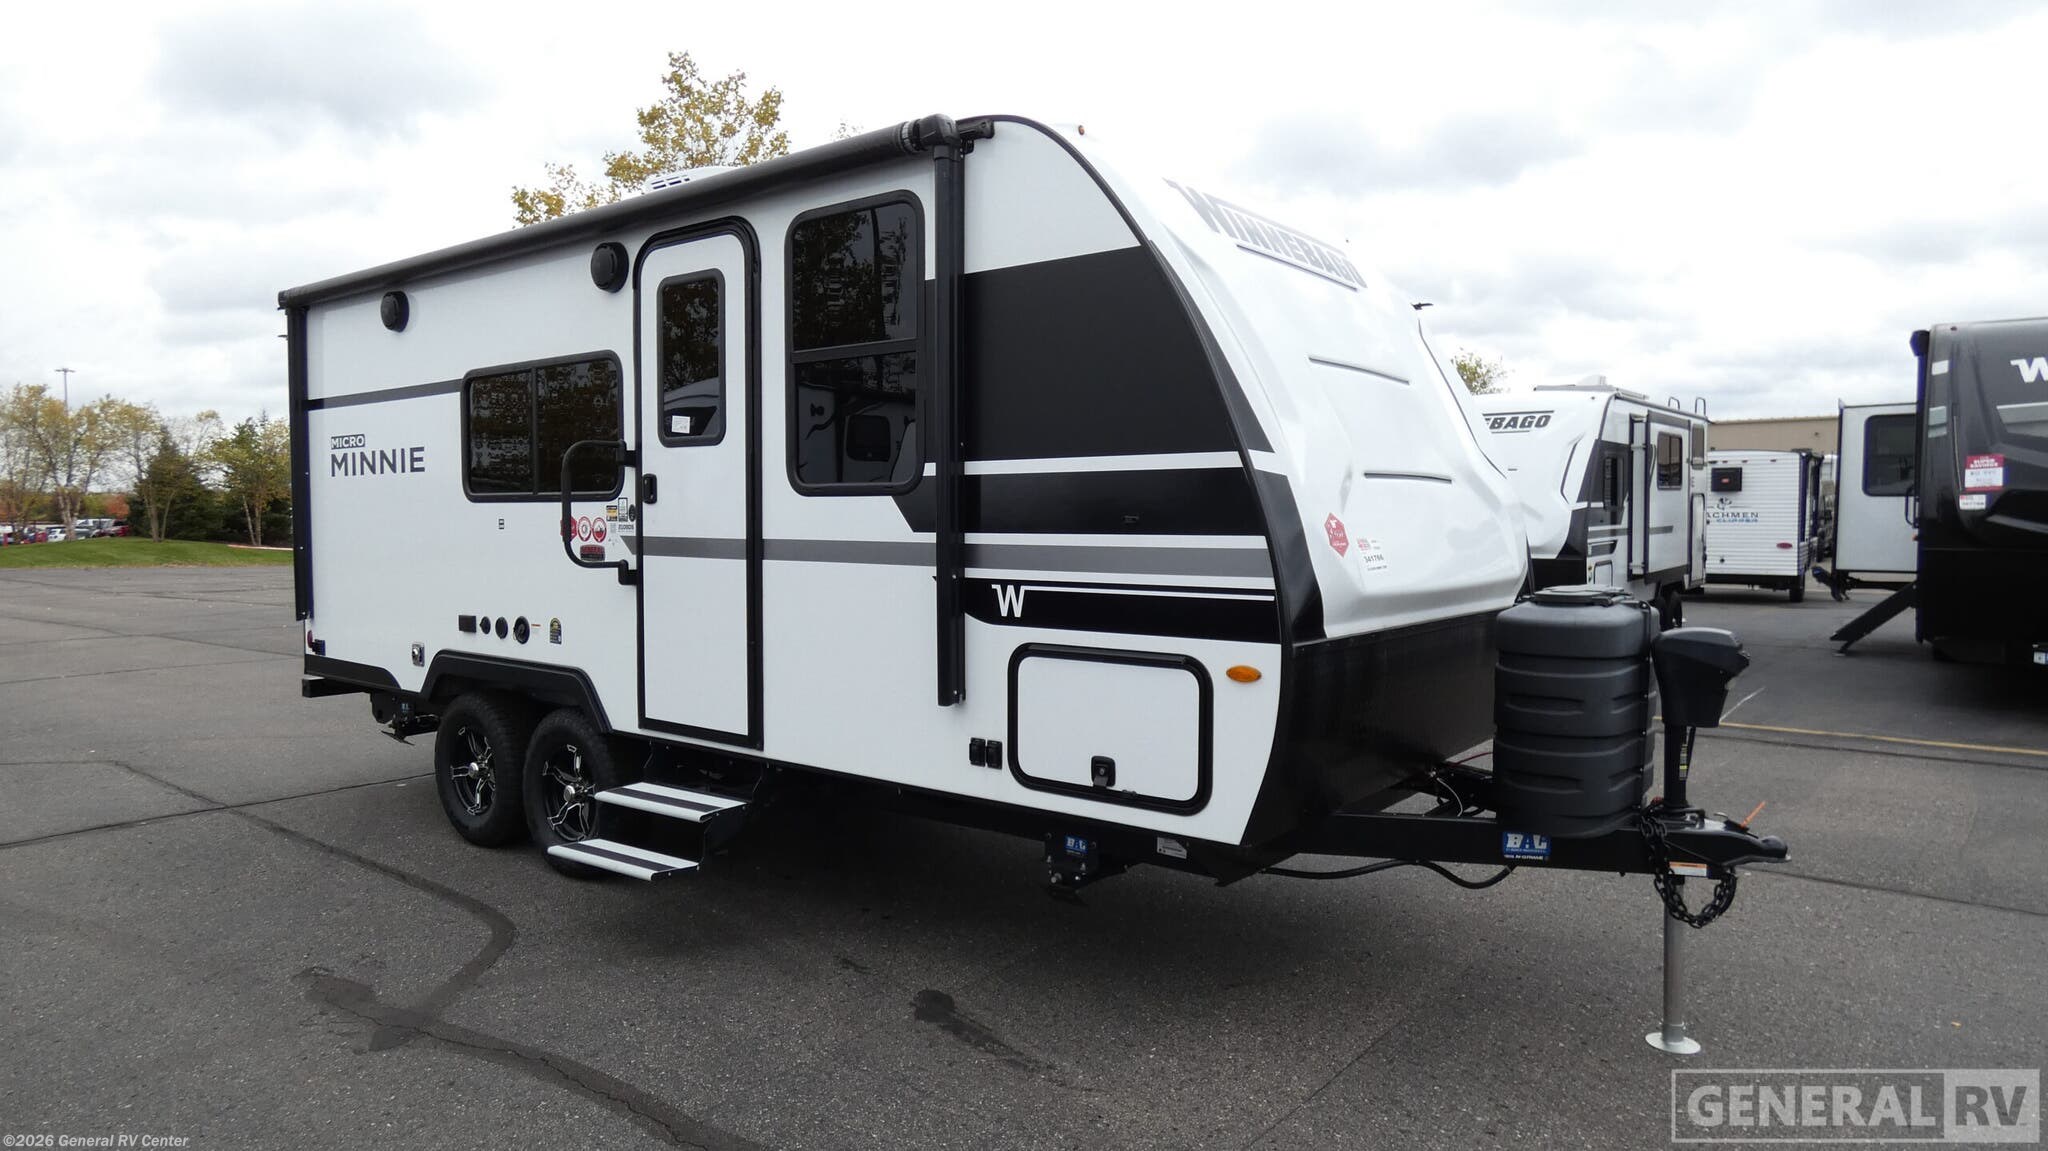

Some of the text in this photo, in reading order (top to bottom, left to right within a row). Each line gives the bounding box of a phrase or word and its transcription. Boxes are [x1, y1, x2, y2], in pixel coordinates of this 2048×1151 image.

[1161, 177, 1368, 289] WINNEBAGO
[331, 434, 365, 449] MICRO
[331, 446, 425, 477] MINNIE
[991, 584, 1025, 618] W
